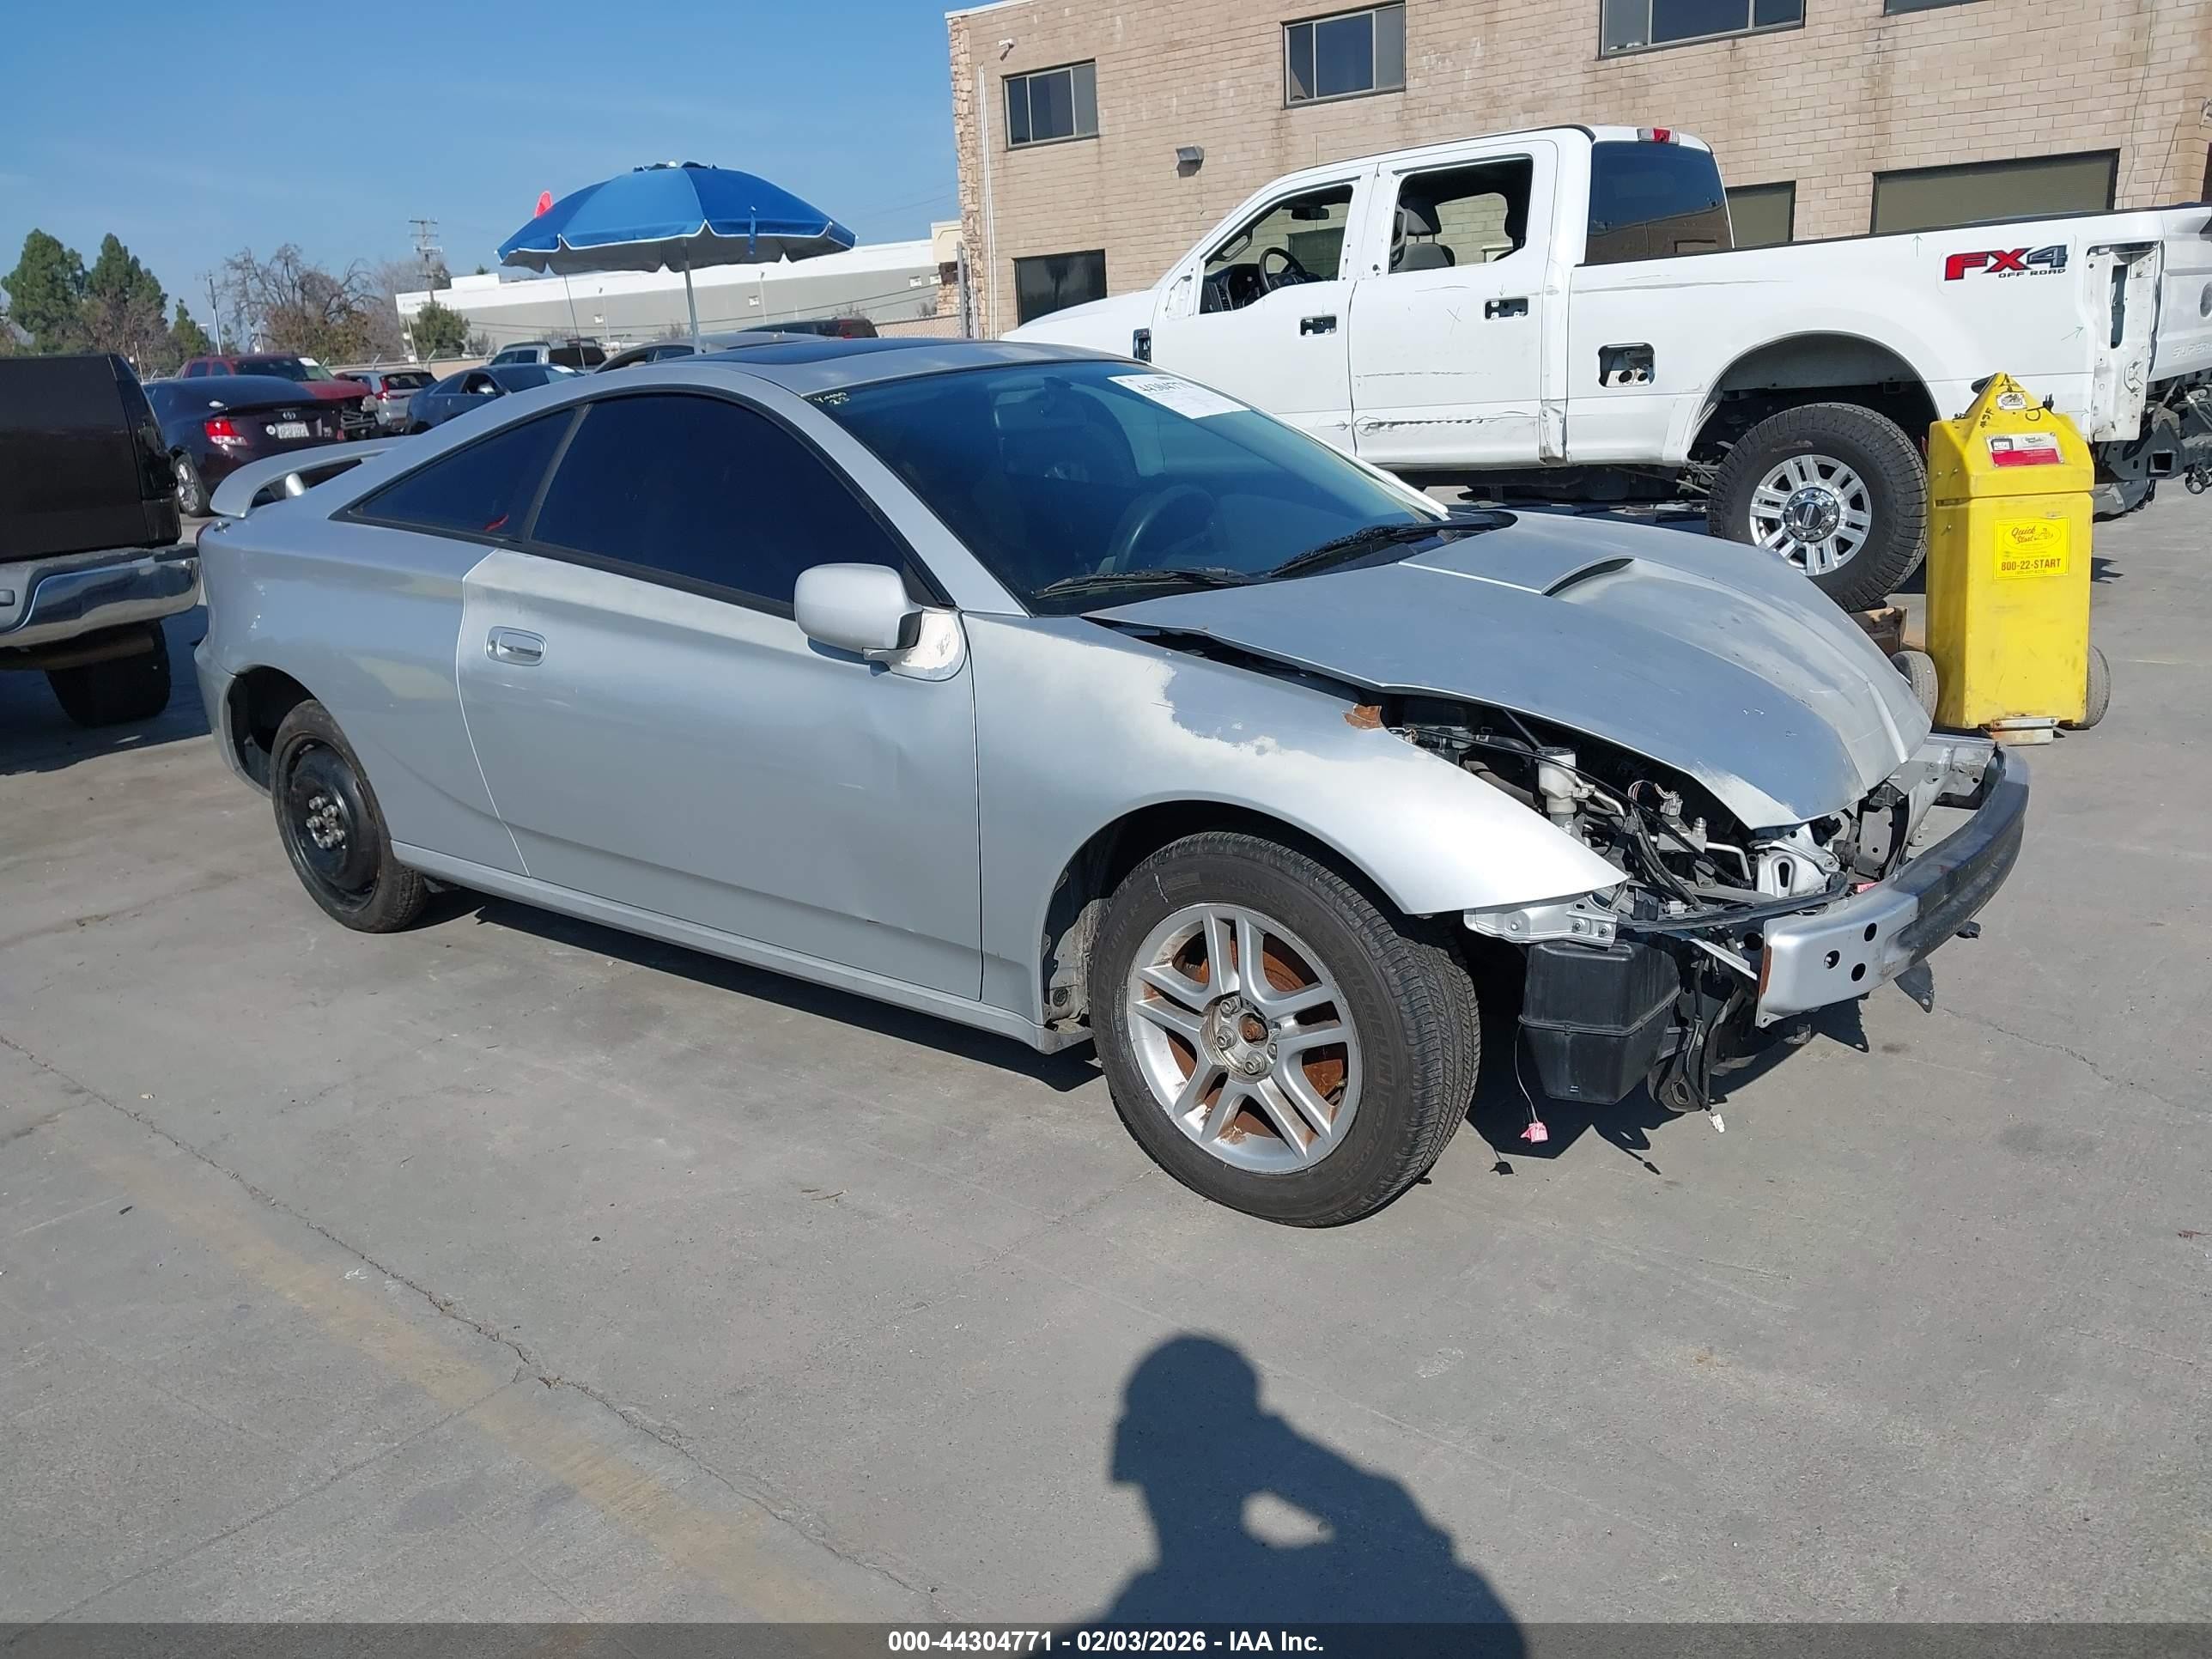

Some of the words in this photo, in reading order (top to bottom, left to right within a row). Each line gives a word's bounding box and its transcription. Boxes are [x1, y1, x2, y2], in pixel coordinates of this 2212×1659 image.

[1944, 245, 2068, 281] FX4
[2011, 526, 2036, 539] Quick
[2001, 558, 2061, 571] 800-22-START
